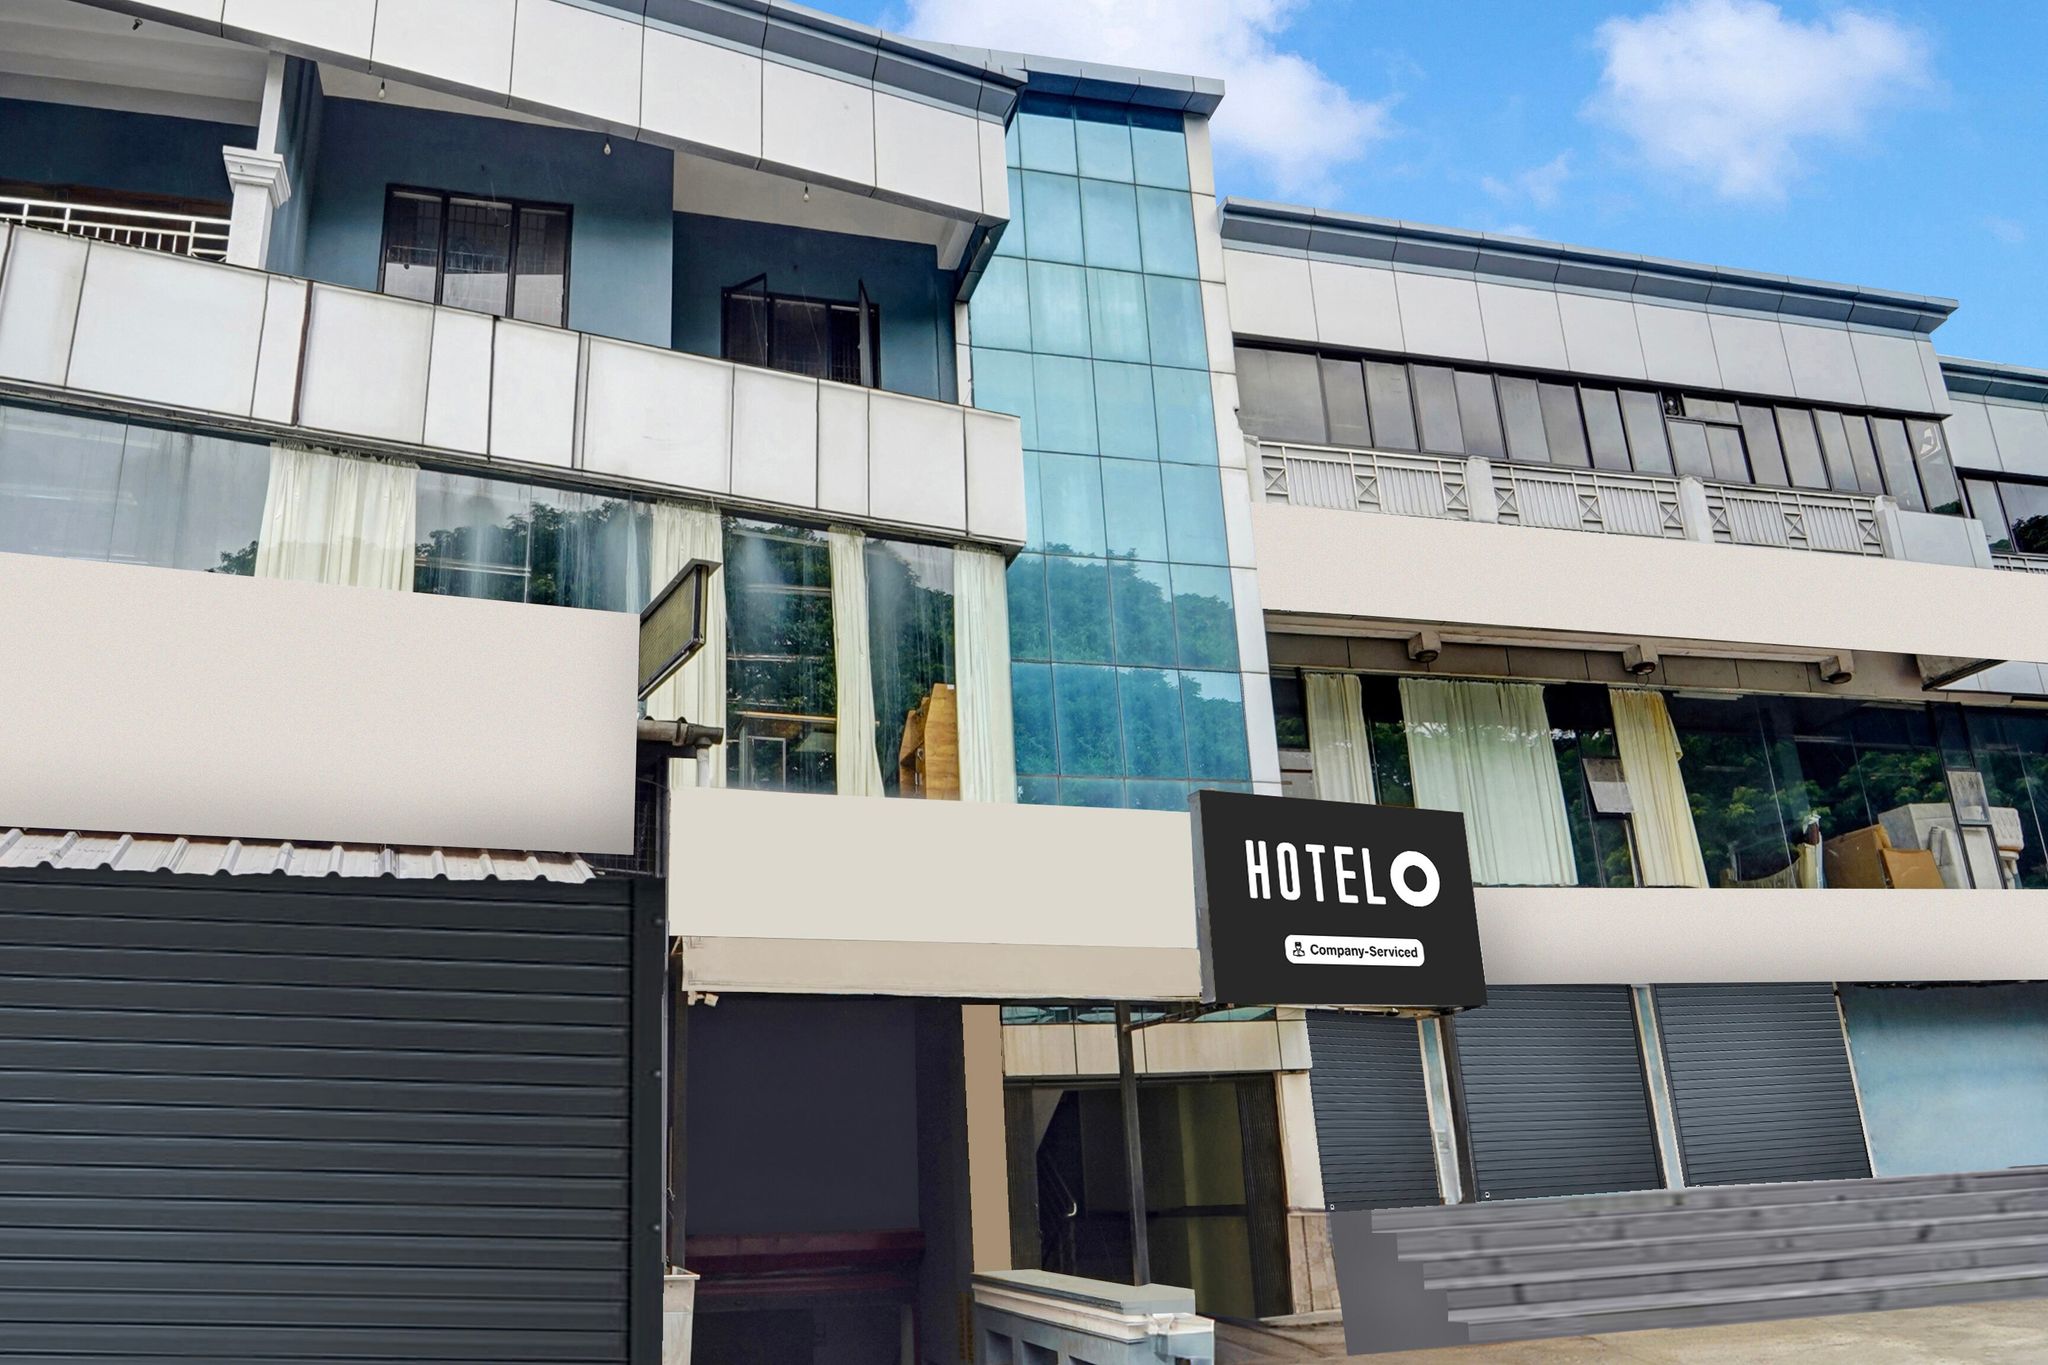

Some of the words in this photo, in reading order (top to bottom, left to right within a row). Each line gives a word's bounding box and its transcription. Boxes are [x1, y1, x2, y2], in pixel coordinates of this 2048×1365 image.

[1245, 839, 1387, 905] HOTEL
[1389, 850, 1441, 908] O
[1310, 943, 1418, 959] Company-Serviced
